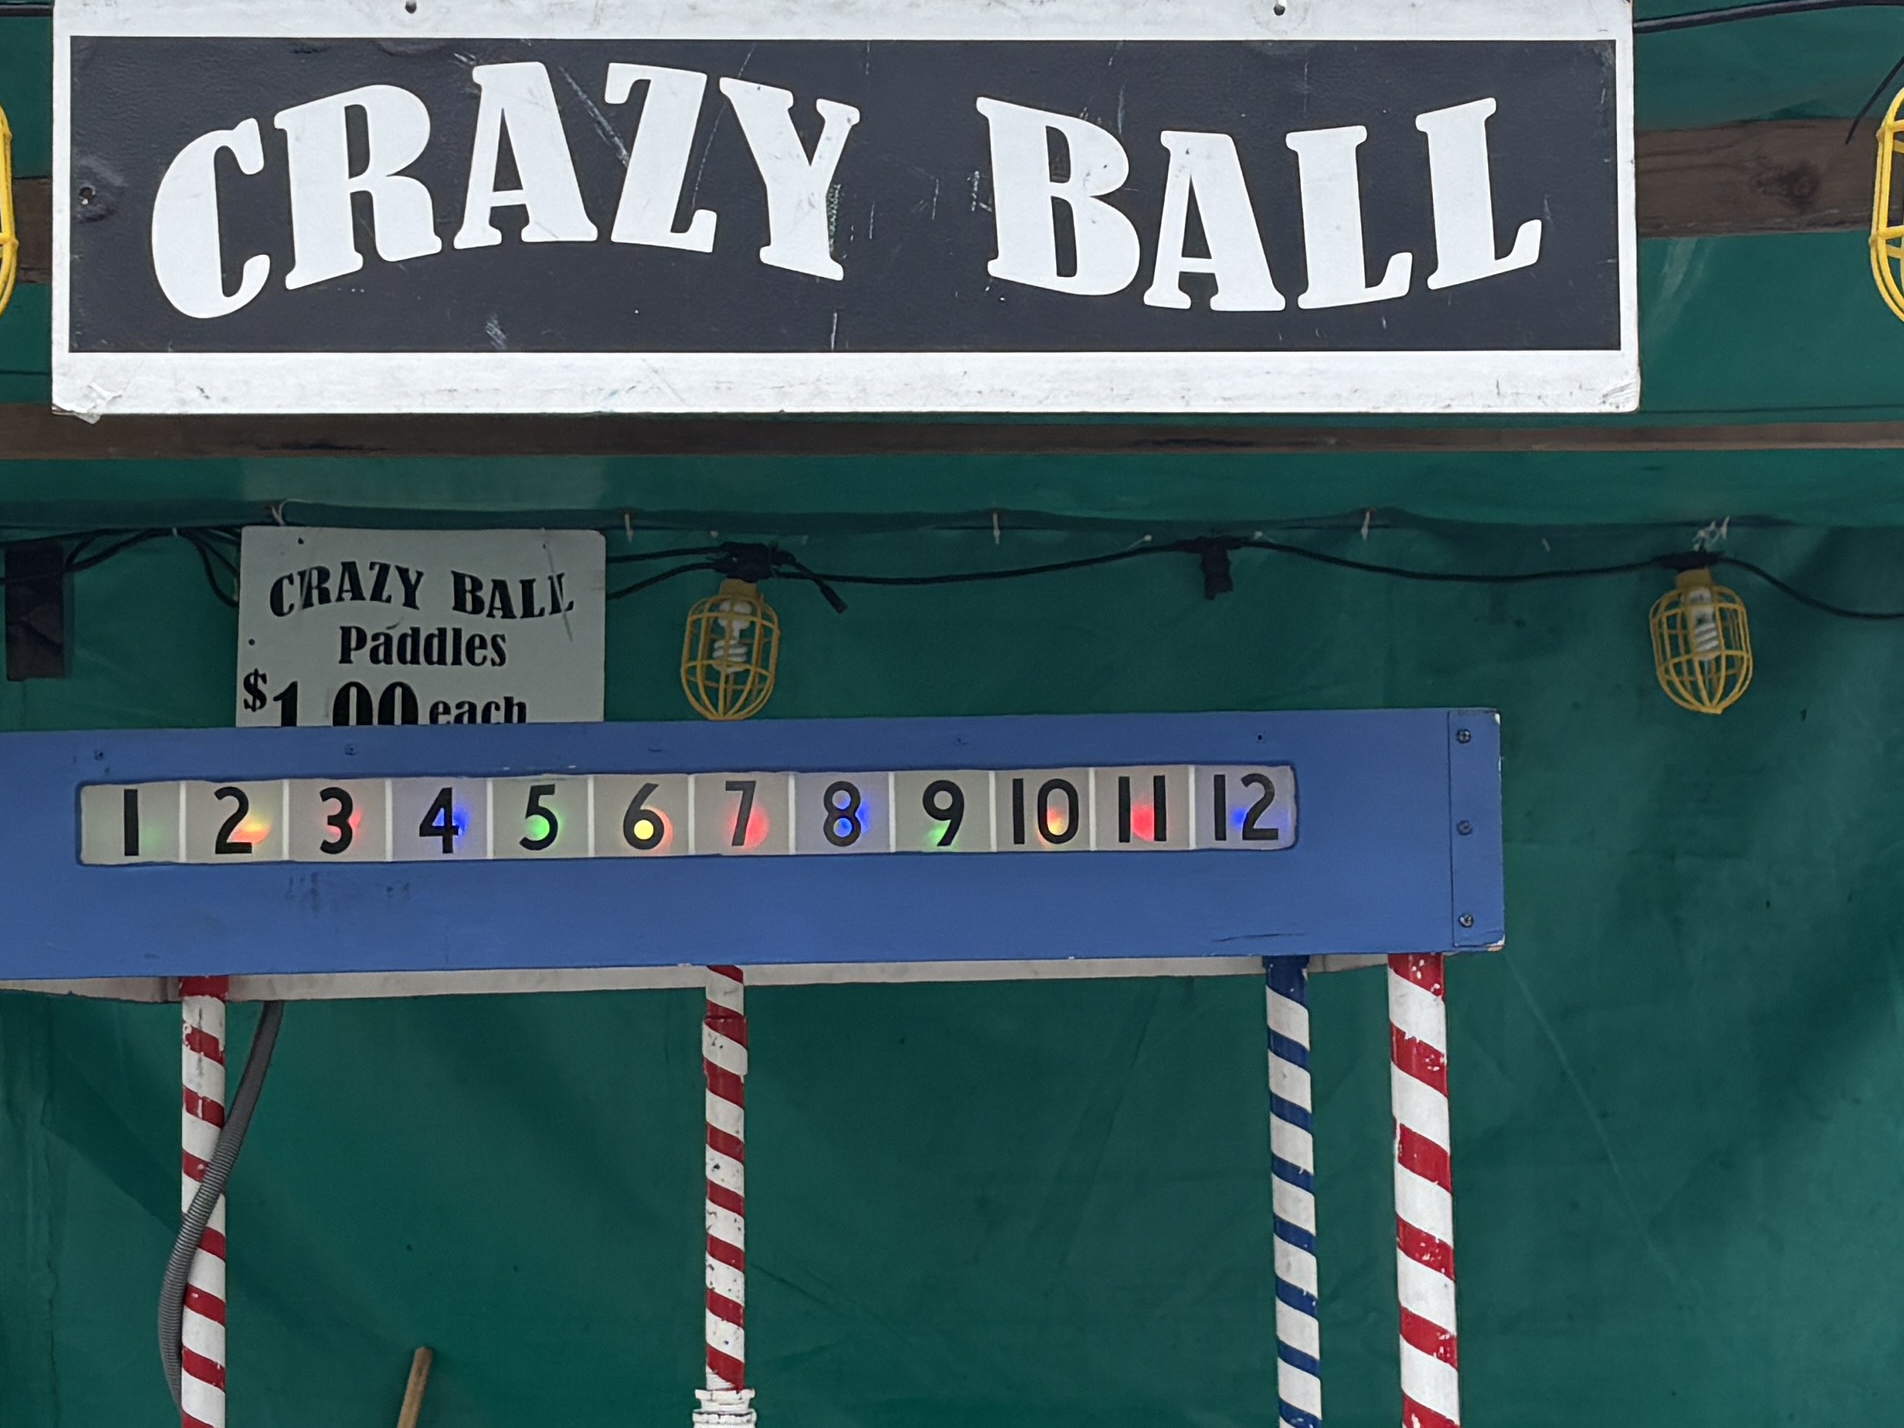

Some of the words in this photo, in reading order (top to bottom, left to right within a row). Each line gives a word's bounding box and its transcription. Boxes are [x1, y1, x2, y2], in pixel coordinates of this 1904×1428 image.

[150, 59, 861, 320] CRAZY
[975, 95, 1542, 314] BALL
[269, 560, 424, 617] CRAZY
[451, 569, 574, 619] BALL
[338, 626, 507, 667] Paddles
[429, 696, 527, 724] each
[121, 787, 141, 858] 1
[213, 785, 255, 856] 2
[318, 784, 356, 856] 3
[418, 784, 461, 856] 4
[518, 782, 559, 854] 5
[622, 781, 660, 852] 6
[725, 779, 758, 849] 7
[824, 779, 863, 849] 8
[923, 778, 965, 850] 9
[1010, 776, 1081, 847] 10
[1117, 773, 1168, 845] 11
[1212, 771, 1281, 843] 12
